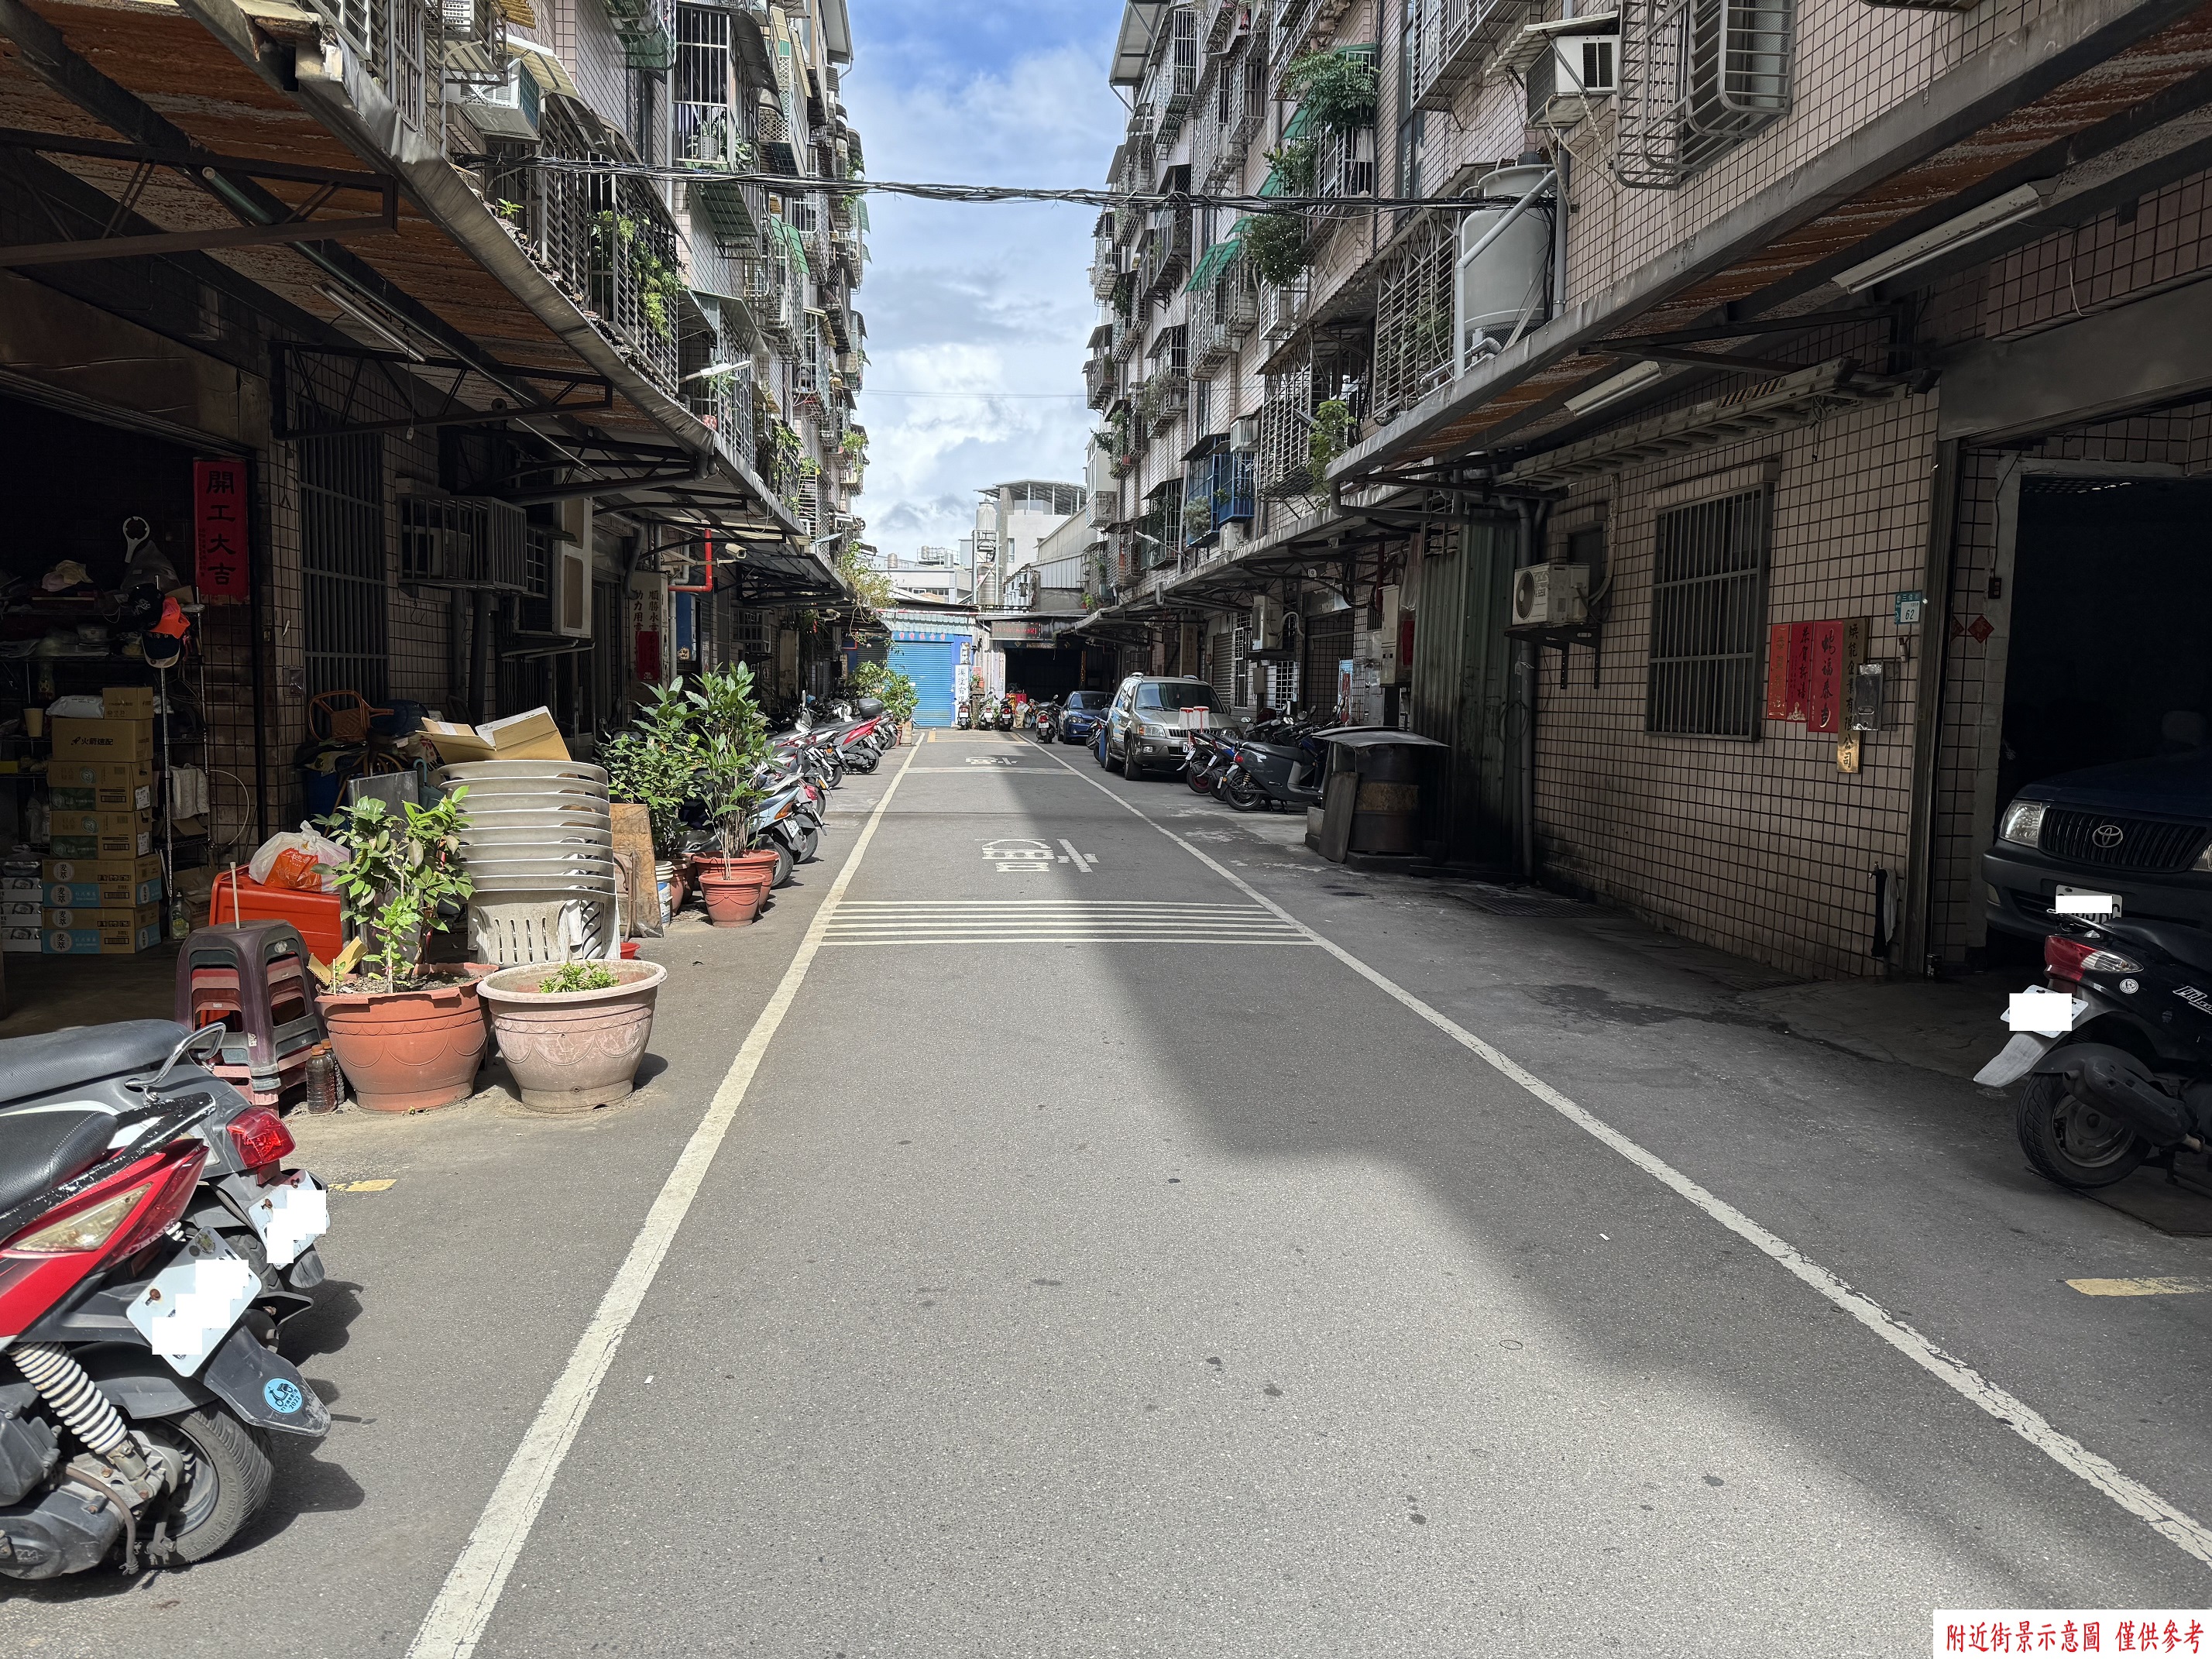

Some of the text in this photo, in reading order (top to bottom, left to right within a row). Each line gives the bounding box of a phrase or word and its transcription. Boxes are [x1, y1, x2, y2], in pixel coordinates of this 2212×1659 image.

[205, 470, 236, 585] 開工大吉
[1905, 609, 1915, 620] 62
[288, 1395, 301, 1410] 2022
